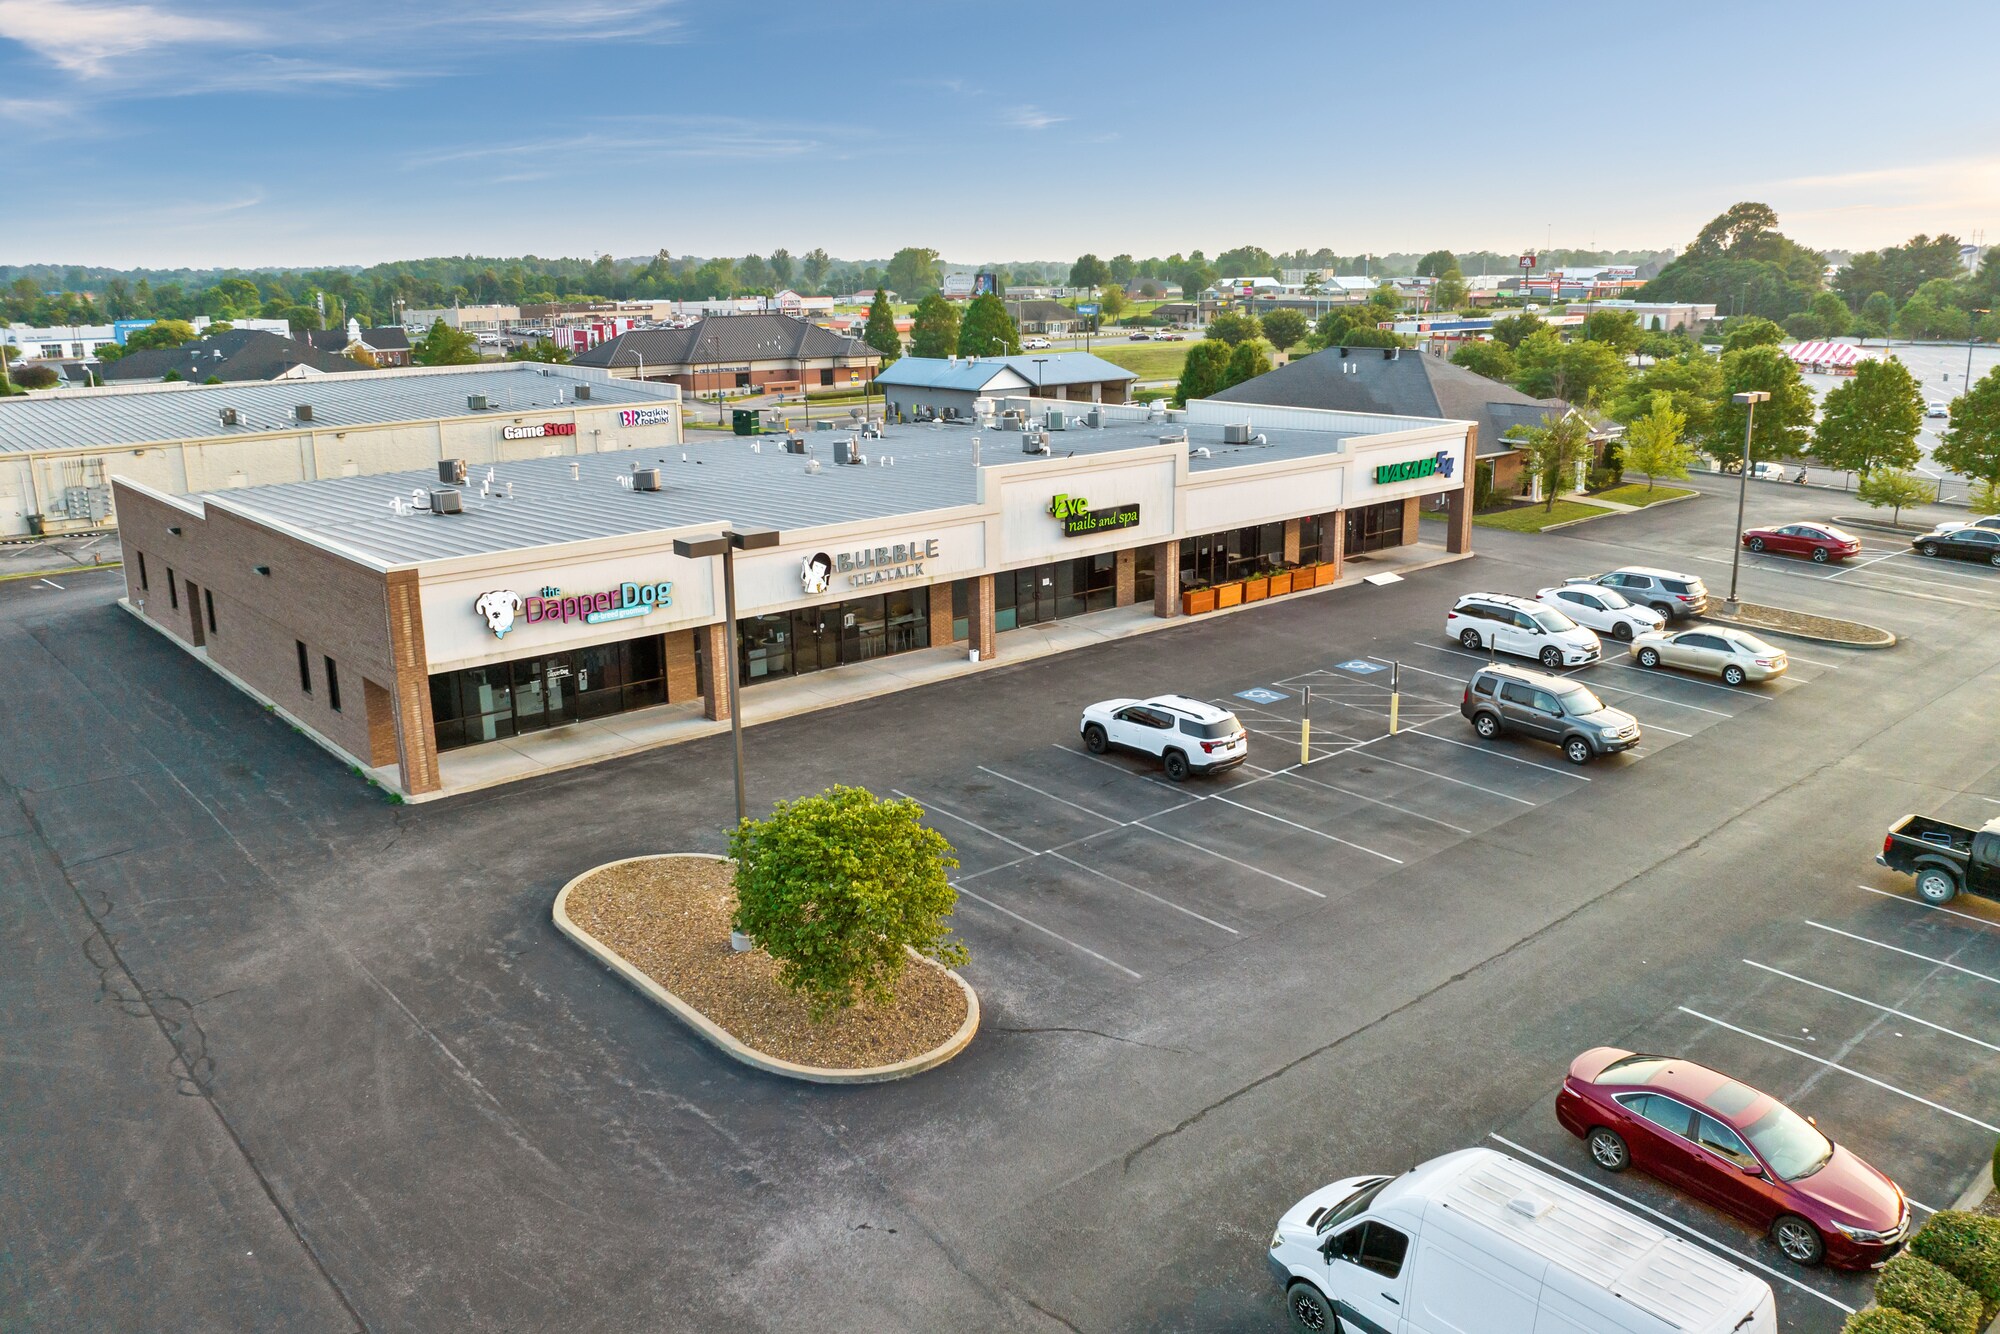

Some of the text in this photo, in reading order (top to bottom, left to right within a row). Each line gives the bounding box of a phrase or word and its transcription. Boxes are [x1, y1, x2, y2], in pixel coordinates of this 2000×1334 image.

[641, 408, 669, 418] baskin
[641, 416, 669, 426] robbins
[503, 422, 577, 440] GameStop
[1376, 450, 1455, 485] WASABI 54
[1050, 493, 1089, 519] Eve
[1068, 510, 1138, 532] nails and spa
[836, 538, 940, 574] BUBBLE
[541, 585, 561, 599] the
[589, 604, 650, 622] all-breed grooming
